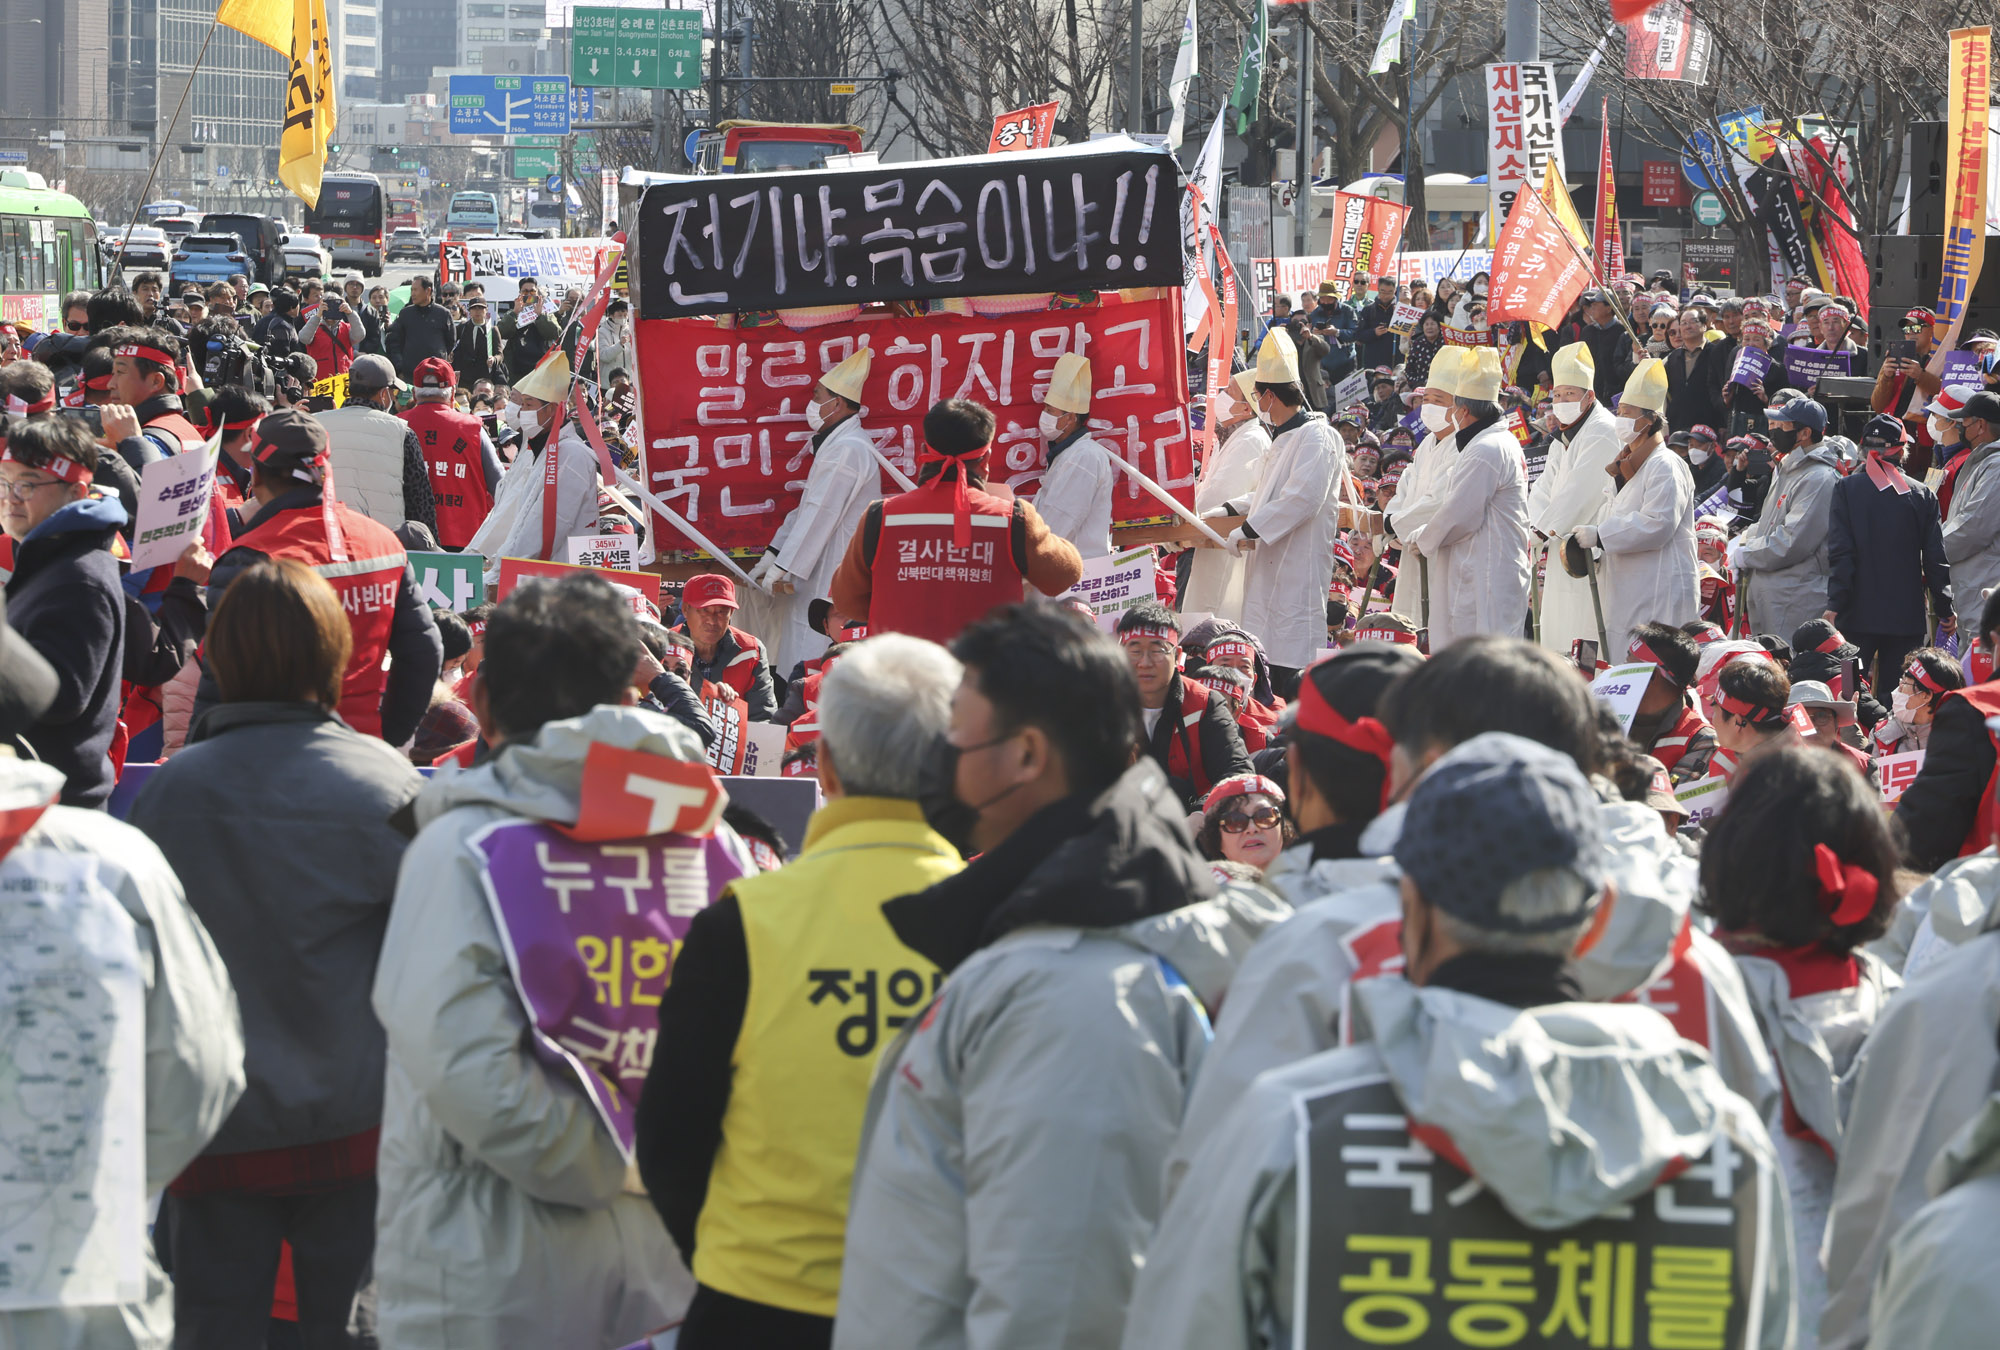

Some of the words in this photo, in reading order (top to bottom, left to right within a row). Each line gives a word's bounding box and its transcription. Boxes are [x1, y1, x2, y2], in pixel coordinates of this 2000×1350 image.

[620, 17, 655, 30] 숭례문
[661, 19, 700, 31] 신촌로터리
[579, 46, 610, 55] 1.2차로
[617, 47, 658, 57] 3.4.5차로
[668, 49, 691, 58] 6차로
[496, 79, 519, 88] 서울역
[534, 94, 565, 103] 서소문로
[456, 108, 480, 117] 소공로
[534, 112, 565, 121] 덕수궁길
[1492, 65, 1526, 181] 지산지소
[1522, 65, 1557, 179] 국가산단
[336, 191, 351, 199] 1000
[663, 185, 858, 304] 전기냐.
[861, 164, 1159, 288] 목숨이냐!!
[471, 249, 505, 277] 초고압
[506, 247, 539, 278] 송전탑
[1445, 328, 1489, 344] 송전선로
[454, 463, 466, 479] 대
[158, 478, 197, 502] 수도권
[139, 521, 187, 546] 민주적인
[595, 539, 617, 548] 345kV
[898, 538, 994, 565] 결사반대
[578, 550, 631, 566] 송전선로
[897, 566, 993, 583] 신북면대책위원회
[1071, 578, 1102, 593] 수도권
[1105, 568, 1141, 586] 전력수요
[338, 580, 398, 614] 사반대
[1090, 585, 1130, 603] 분산하고
[1208, 642, 1247, 659] 결사반대
[535, 840, 712, 918] 누구를
[574, 933, 682, 1009] 위한
[1339, 1234, 1736, 1349] 공동체를
